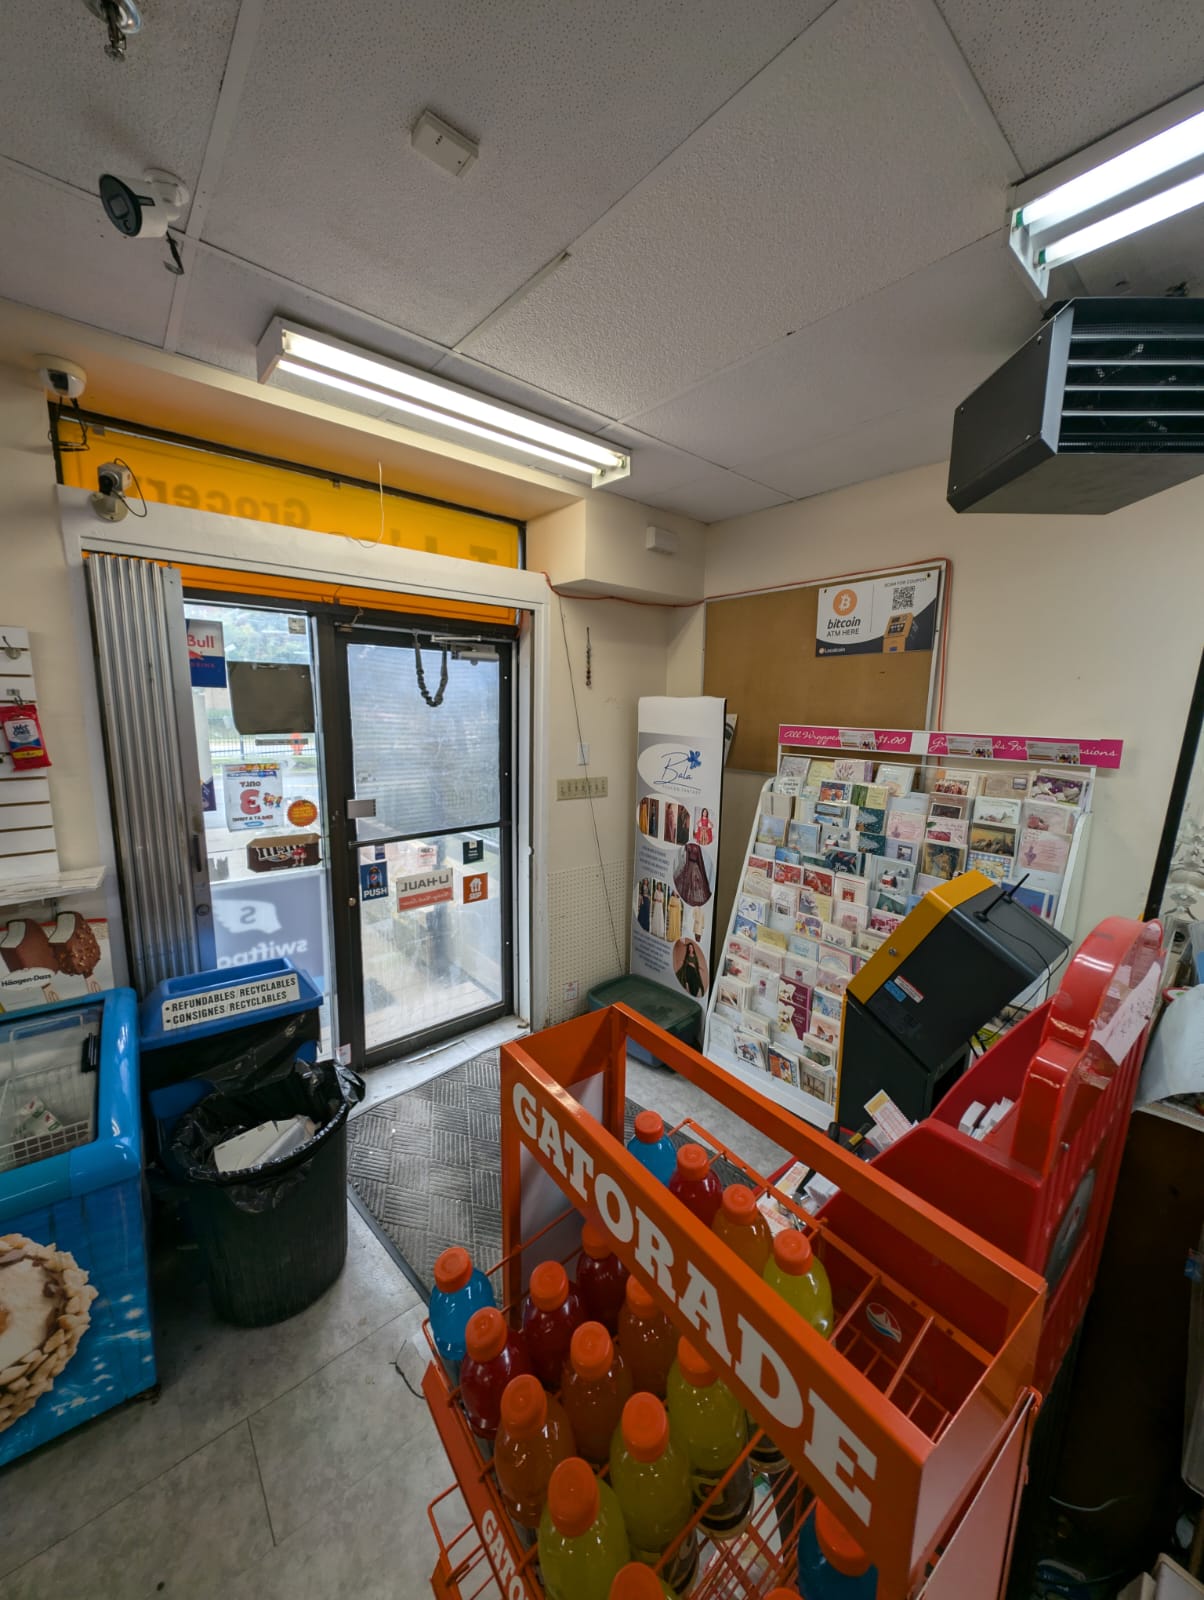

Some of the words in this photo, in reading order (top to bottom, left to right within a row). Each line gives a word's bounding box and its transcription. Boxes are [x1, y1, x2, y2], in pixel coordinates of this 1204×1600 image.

[827, 616, 861, 630] bitcoin
[827, 629, 841, 638] ATM
[842, 628, 860, 636] HERE
[187, 634, 215, 649] Bull
[784, 730, 801, 738] All
[877, 735, 907, 745] $1.00
[363, 886, 388, 898] PUSH
[513, 1081, 878, 1527] GATORADE
